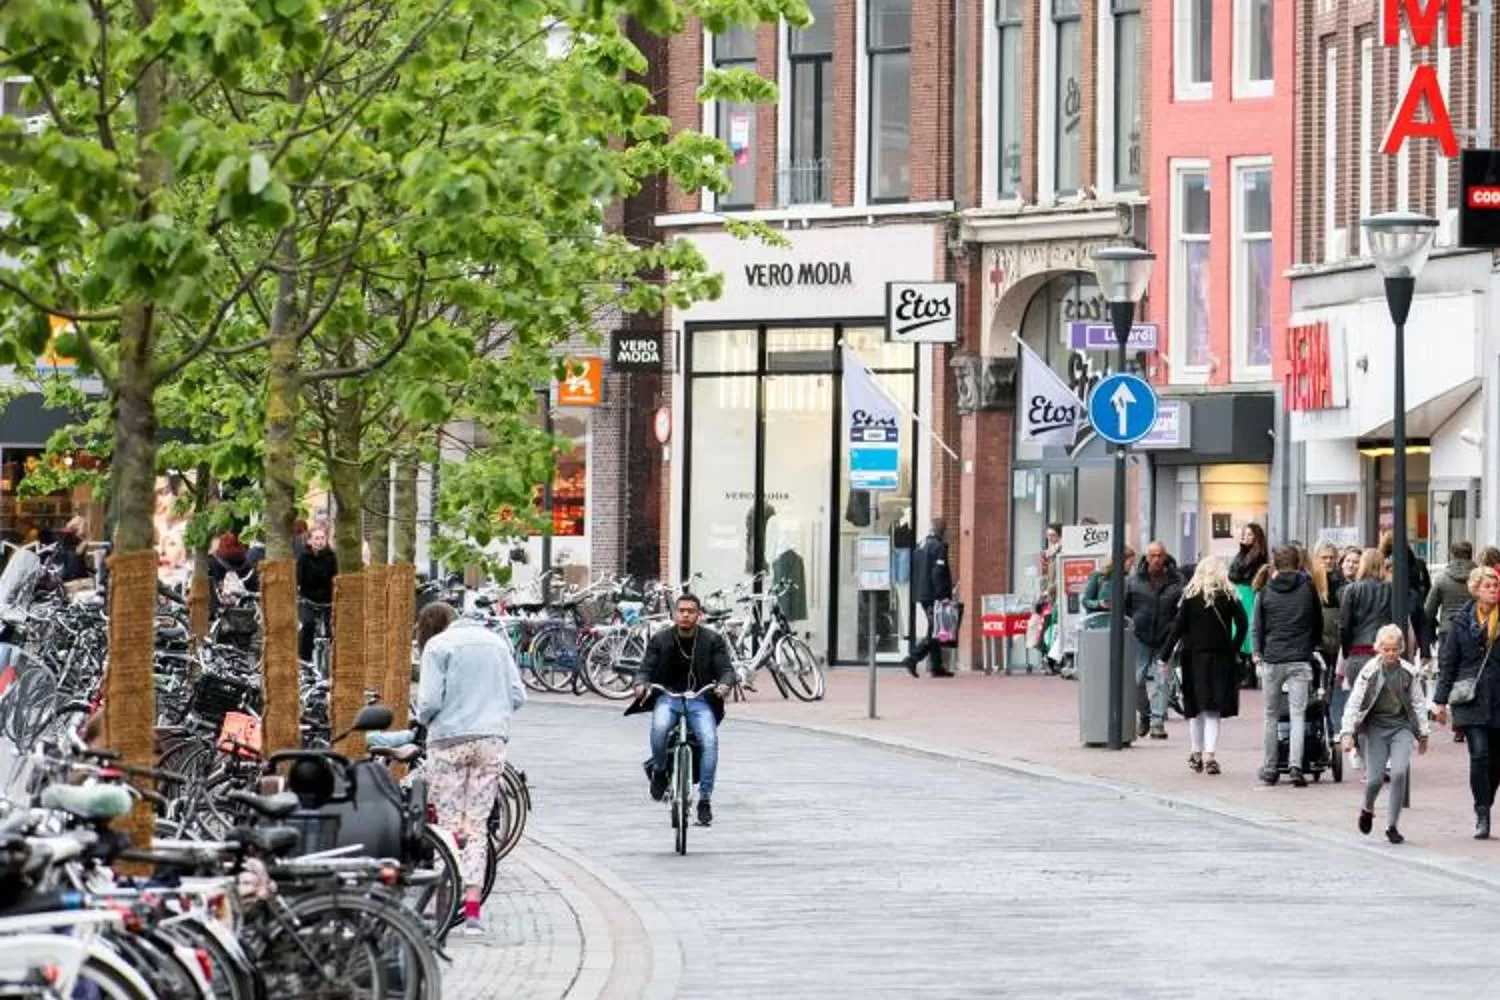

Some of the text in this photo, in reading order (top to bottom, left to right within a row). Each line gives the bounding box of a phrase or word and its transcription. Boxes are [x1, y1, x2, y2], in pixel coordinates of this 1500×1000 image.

[745, 261, 852, 287] VERO MODA
[896, 289, 952, 323] Etos
[617, 351, 661, 364] MODA
[619, 339, 657, 352] VERO
[1028, 395, 1076, 425] Etos
